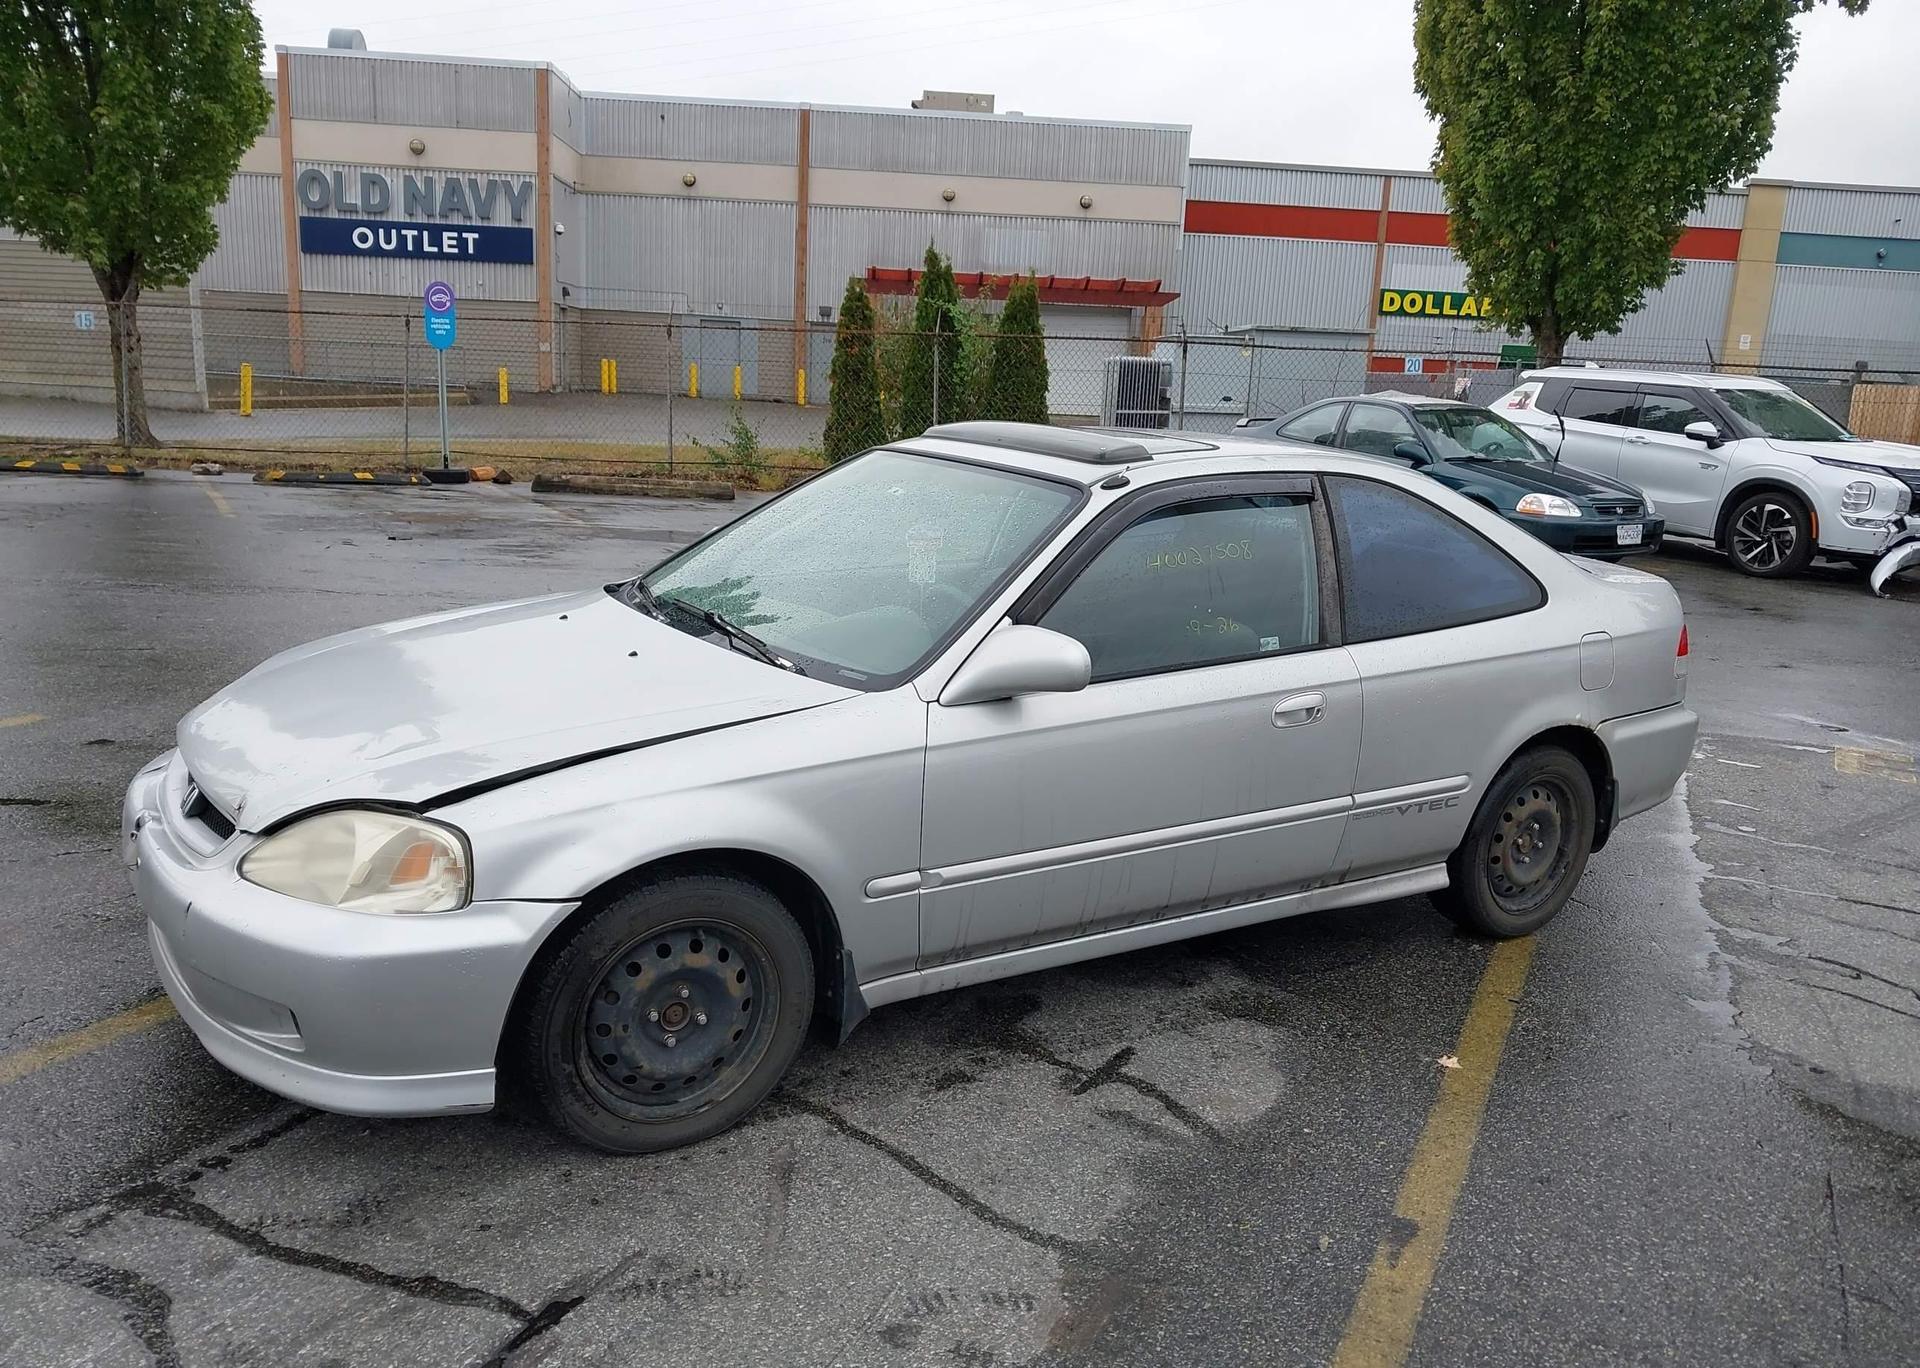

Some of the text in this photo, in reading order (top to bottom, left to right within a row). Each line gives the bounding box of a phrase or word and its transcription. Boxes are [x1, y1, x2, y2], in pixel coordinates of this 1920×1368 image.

[297, 168, 534, 223] OLD NAVY
[351, 226, 480, 255] OUTLET
[77, 313, 92, 328] 15
[1407, 357, 1421, 373] 20
[1396, 796, 1460, 817] VTEC
